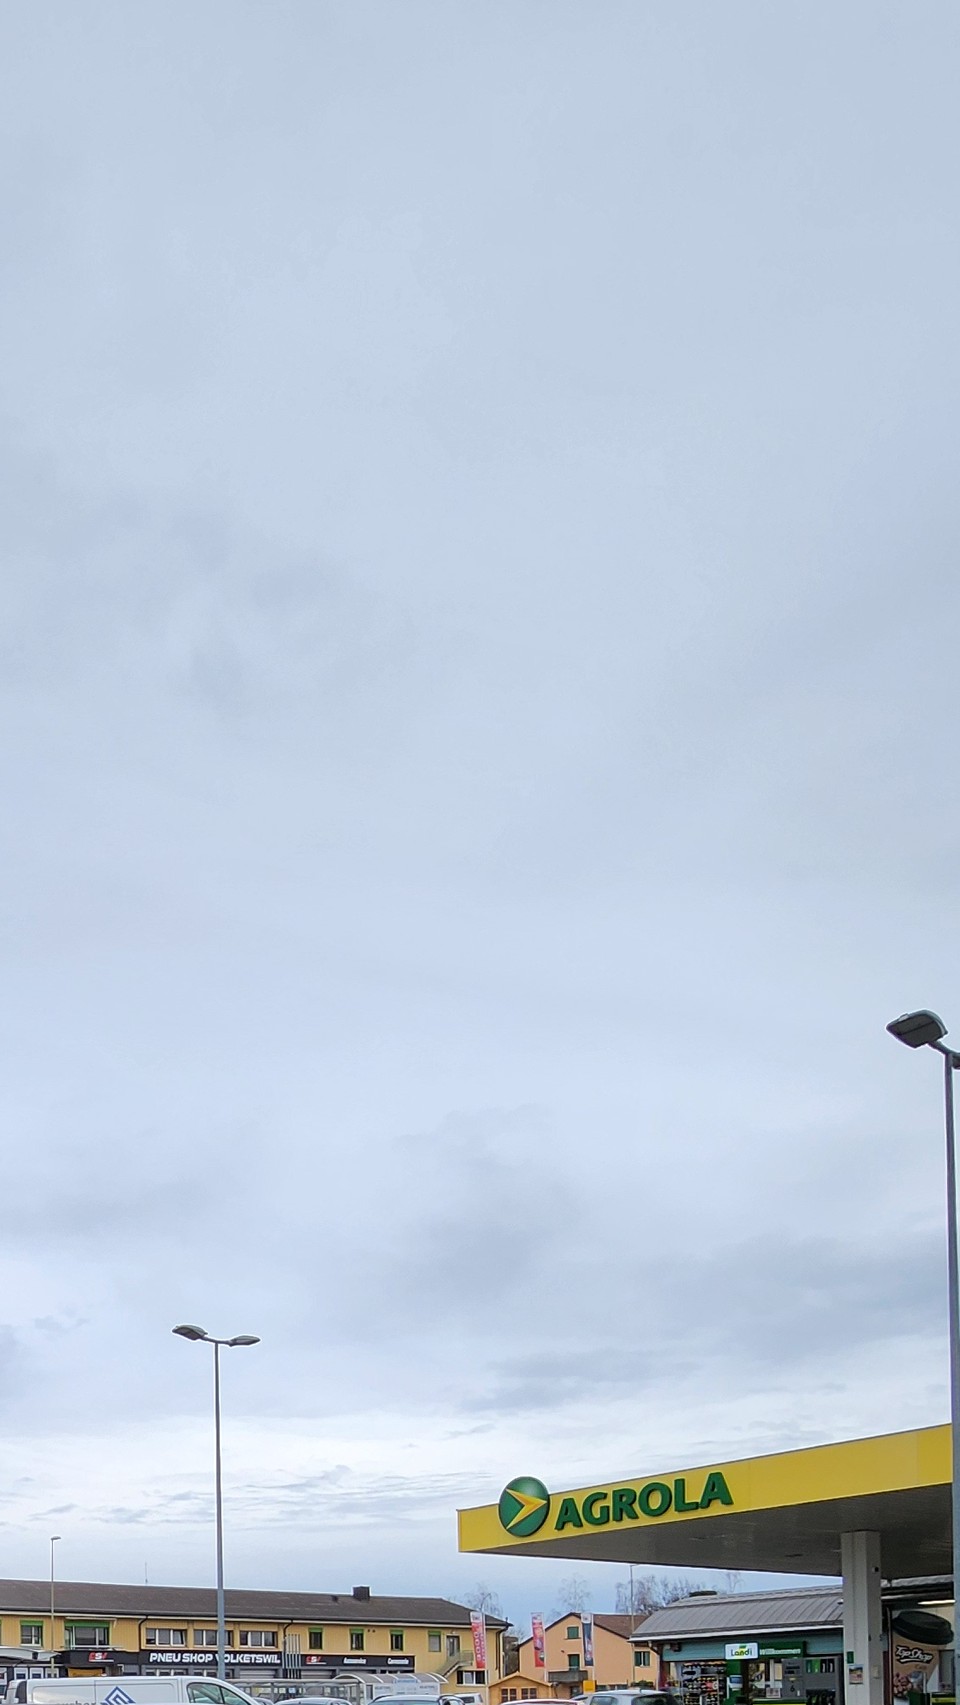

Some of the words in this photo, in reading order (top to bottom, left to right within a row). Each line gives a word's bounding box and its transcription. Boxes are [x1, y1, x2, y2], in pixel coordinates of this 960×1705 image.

[554, 1471, 734, 1530] AGROLA
[149, 1653, 181, 1662] PNEU
[181, 1653, 214, 1663] SHOP
